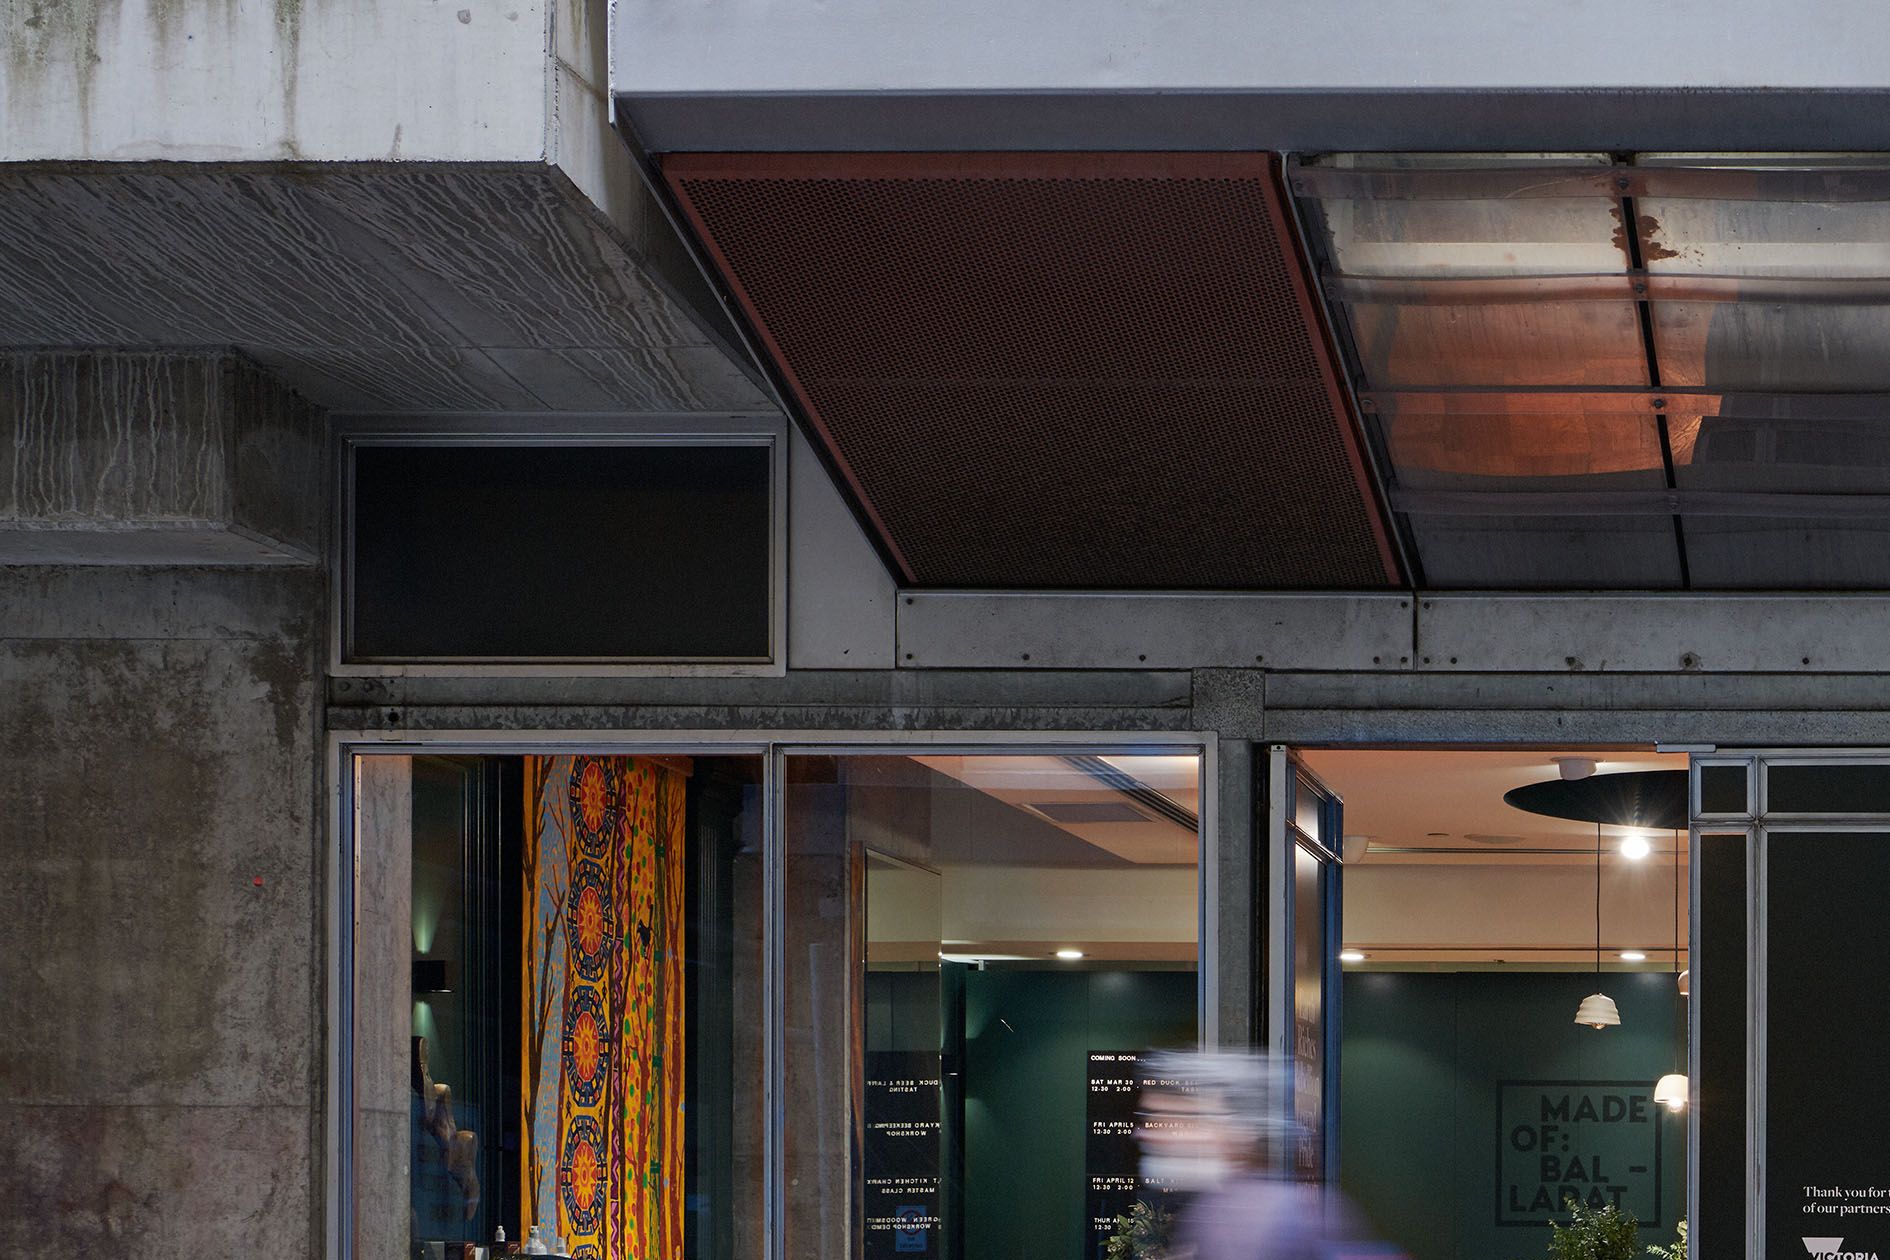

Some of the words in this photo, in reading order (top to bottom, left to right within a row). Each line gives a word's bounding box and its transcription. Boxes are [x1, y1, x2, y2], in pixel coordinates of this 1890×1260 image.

[1541, 1094, 1648, 1123] MADE
[1510, 1124, 1570, 1152] OF:
[1803, 1186, 1842, 1198] Thank
[1844, 1189, 1866, 1201] you
[1868, 1186, 1886, 1198] for
[1803, 1202, 1817, 1214] of
[1817, 1204, 1838, 1214] our
